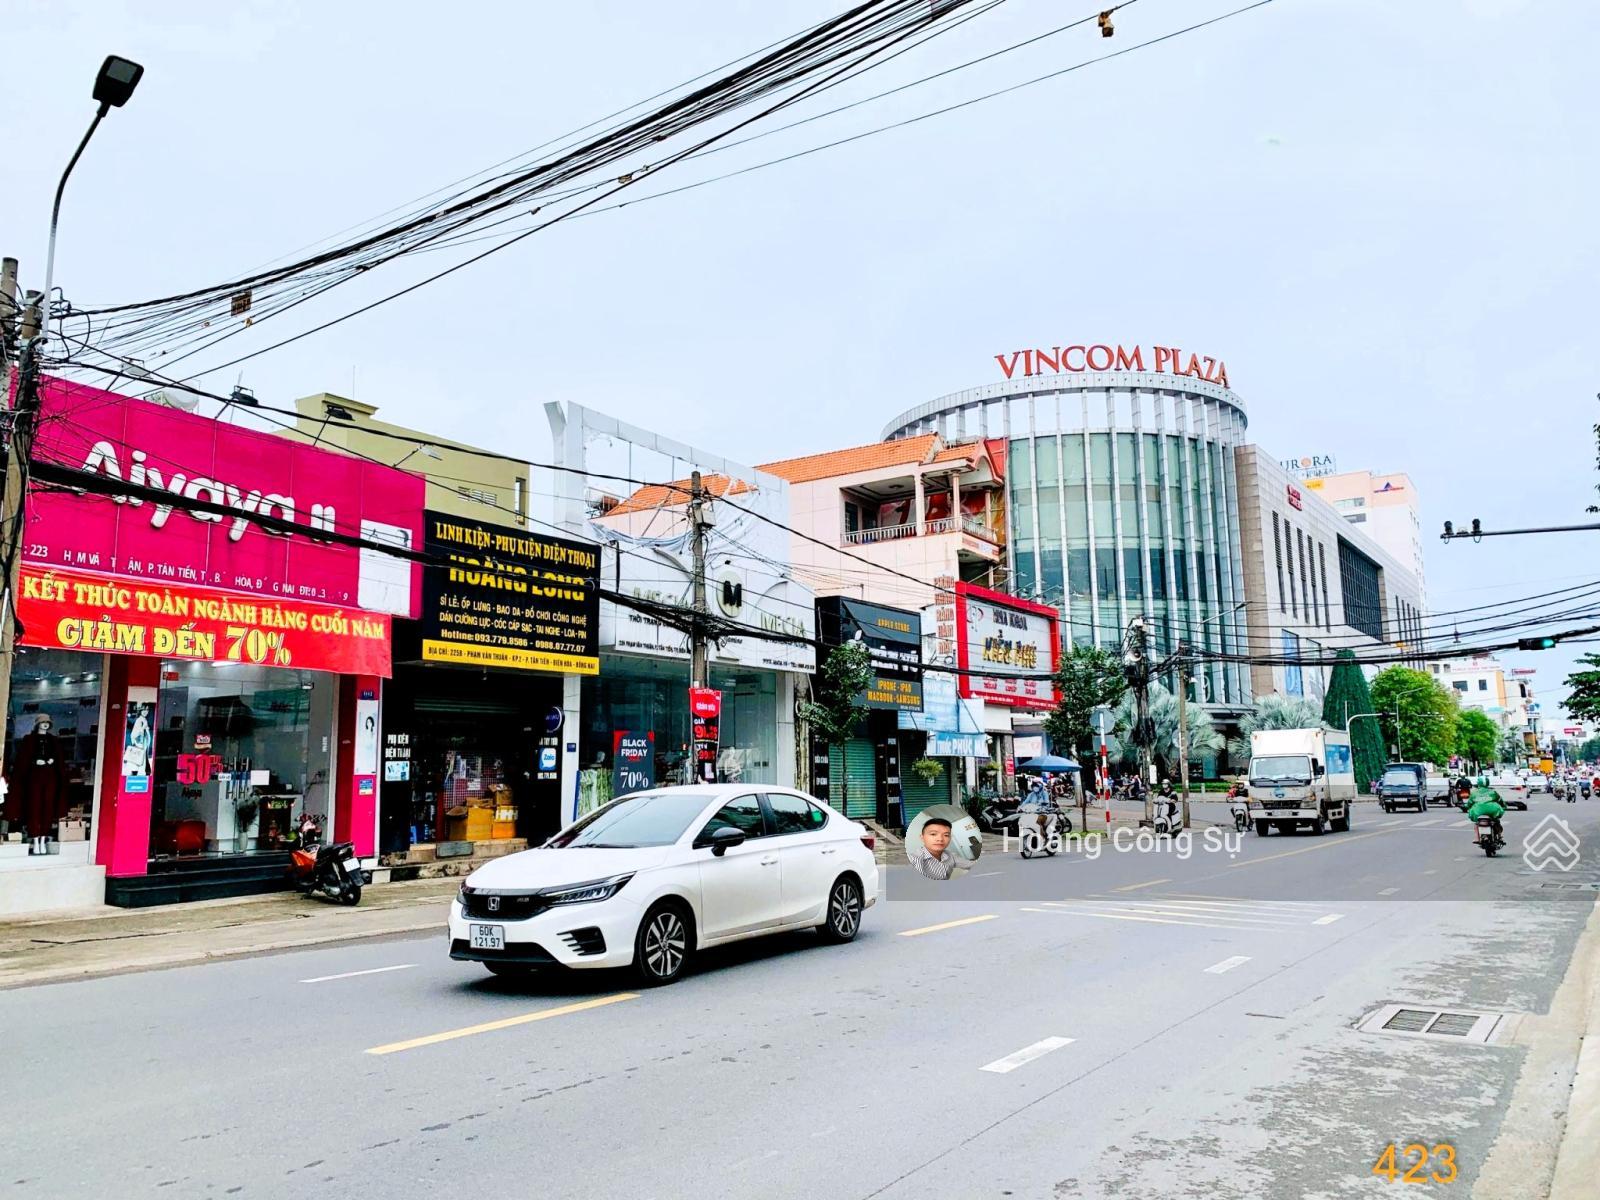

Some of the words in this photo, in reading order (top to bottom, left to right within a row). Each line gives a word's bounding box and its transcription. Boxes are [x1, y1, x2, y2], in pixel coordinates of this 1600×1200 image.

[994, 345, 1147, 379] VINCOM
[1153, 346, 1231, 389] PLAZA
[436, 522, 463, 540] LINH
[464, 526, 490, 550] KIỆN
[495, 538, 516, 556] PHỤ
[517, 538, 542, 560] KIỆN
[543, 543, 567, 565] ĐIỆN
[568, 551, 596, 570] THOẠI
[157, 563, 175, 576] TÂN
[449, 554, 528, 593] HOÀNG
[532, 570, 586, 601] LONG
[23, 570, 68, 602] KẾT
[74, 581, 132, 609] THÚC
[135, 589, 189, 618] TOÀN
[194, 597, 257, 624] NGÀNH
[261, 603, 308, 632] HÀNG
[311, 608, 348, 635] CUỐI
[352, 616, 385, 640] NĂM
[461, 595, 471, 609] ỐP
[473, 600, 491, 612] LƯNG
[496, 604, 511, 615] BAO
[512, 606, 521, 616] DA
[525, 605, 535, 619] ĐỒ
[536, 610, 551, 621] CHƠI
[552, 611, 570, 624] CÔNG
[439, 612, 453, 623] DÁN
[454, 612, 478, 626] CƯỜNG
[508, 619, 520, 631] CÁP
[521, 623, 533, 634] SẠC
[545, 625, 561, 636] NGHE
[564, 628, 575, 638] LOA
[56, 614, 146, 654] GIẢM
[153, 622, 216, 660] ĐẾN
[225, 624, 292, 665] 70%
[441, 628, 474, 641] Hotline:
[622, 739, 646, 747] BLACK
[543, 753, 556, 761] Zalo
[621, 748, 647, 757] FRIDAY
[620, 771, 649, 788] 70%
[479, 926, 494, 937] 60K
[474, 937, 501, 948] 121.97
